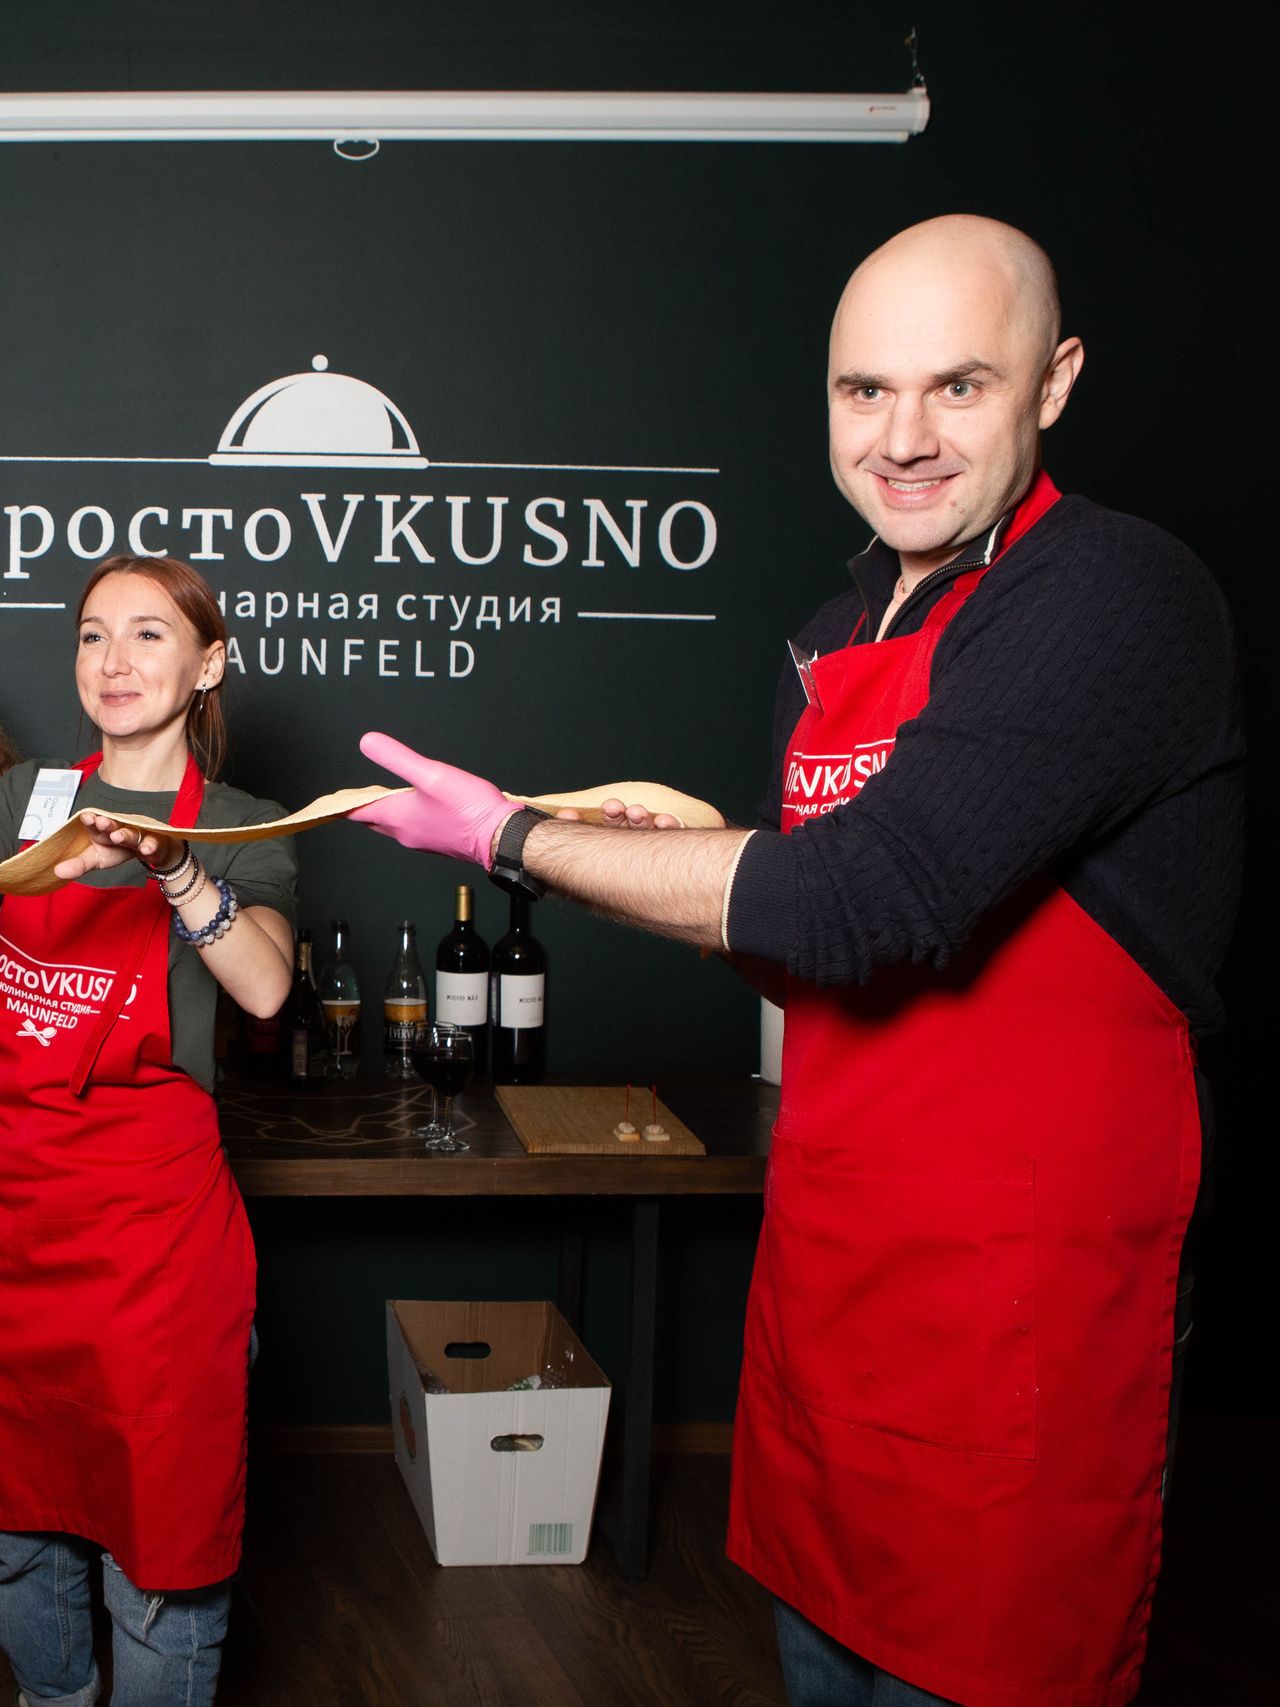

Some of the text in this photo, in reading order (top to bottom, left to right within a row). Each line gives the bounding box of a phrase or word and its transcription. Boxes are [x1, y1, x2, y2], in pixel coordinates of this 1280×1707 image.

[396, 594, 562, 631] студия
[227, 636, 475, 678] AUNFELD
[6, 997, 78, 1029] MAUNFELD
[60, 1001, 92, 1015] СТУДИЯ
